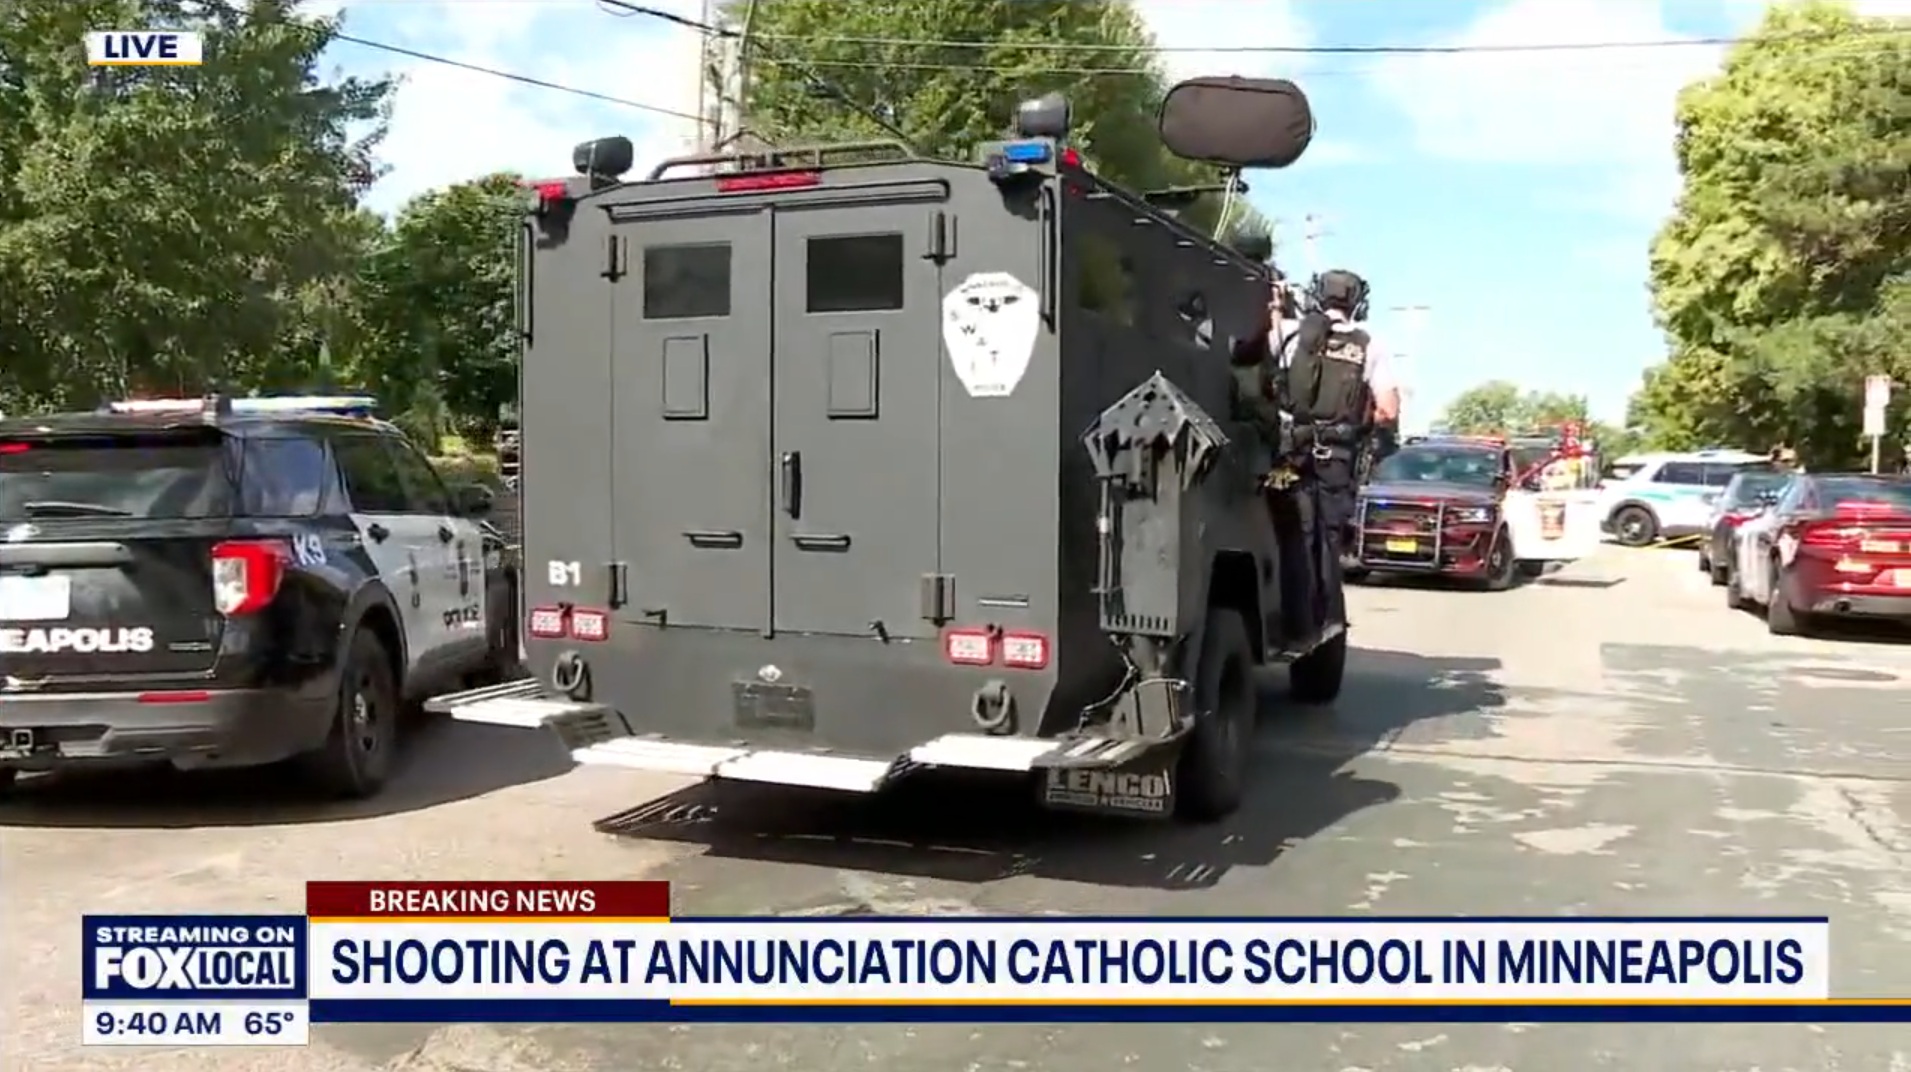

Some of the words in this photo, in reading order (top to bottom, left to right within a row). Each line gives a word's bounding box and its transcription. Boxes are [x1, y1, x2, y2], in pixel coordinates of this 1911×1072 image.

[293, 533, 327, 566] K9
[548, 560, 581, 586] B1
[0, 627, 153, 653] EAPOLIS
[1047, 766, 1164, 797] LENCO
